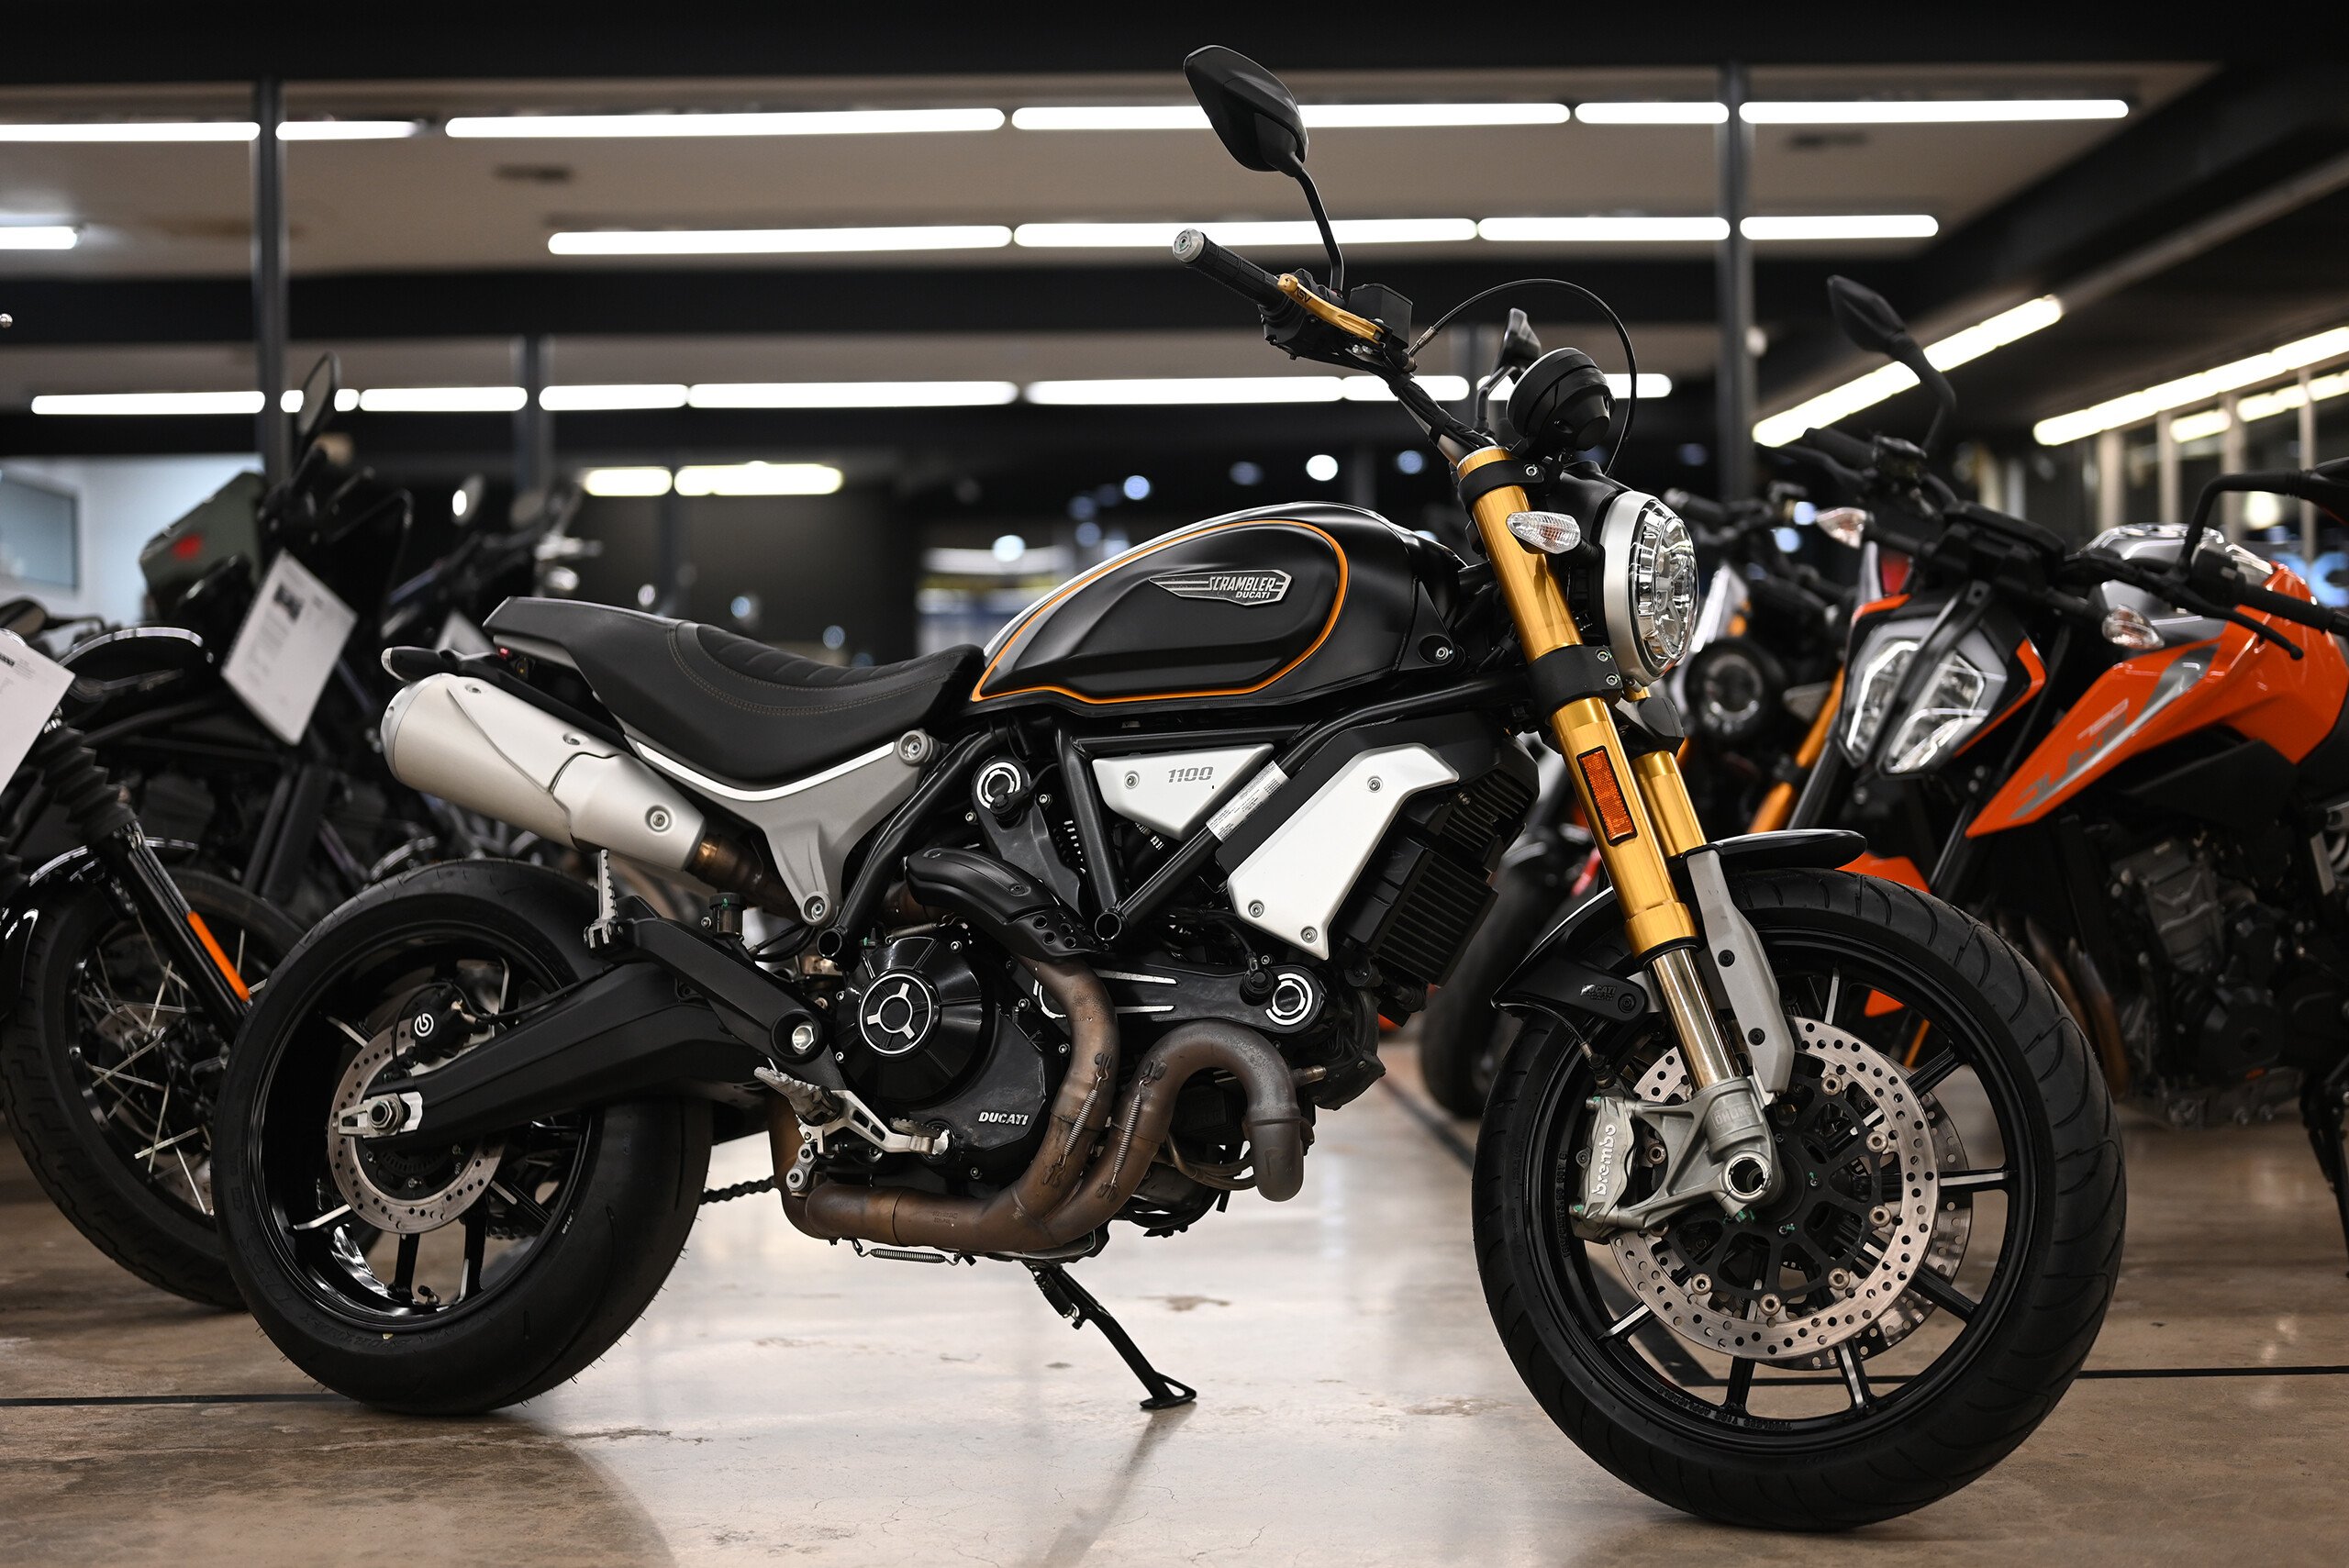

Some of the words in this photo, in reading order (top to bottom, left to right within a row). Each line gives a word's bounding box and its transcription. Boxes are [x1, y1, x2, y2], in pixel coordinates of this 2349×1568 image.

[1209, 576, 1276, 592] SCRAMBLER
[1235, 591, 1271, 599] DUCATI
[1168, 766, 1214, 783] 1100
[978, 1111, 1029, 1126] DUCATI
[1592, 1124, 1617, 1195] brembo
